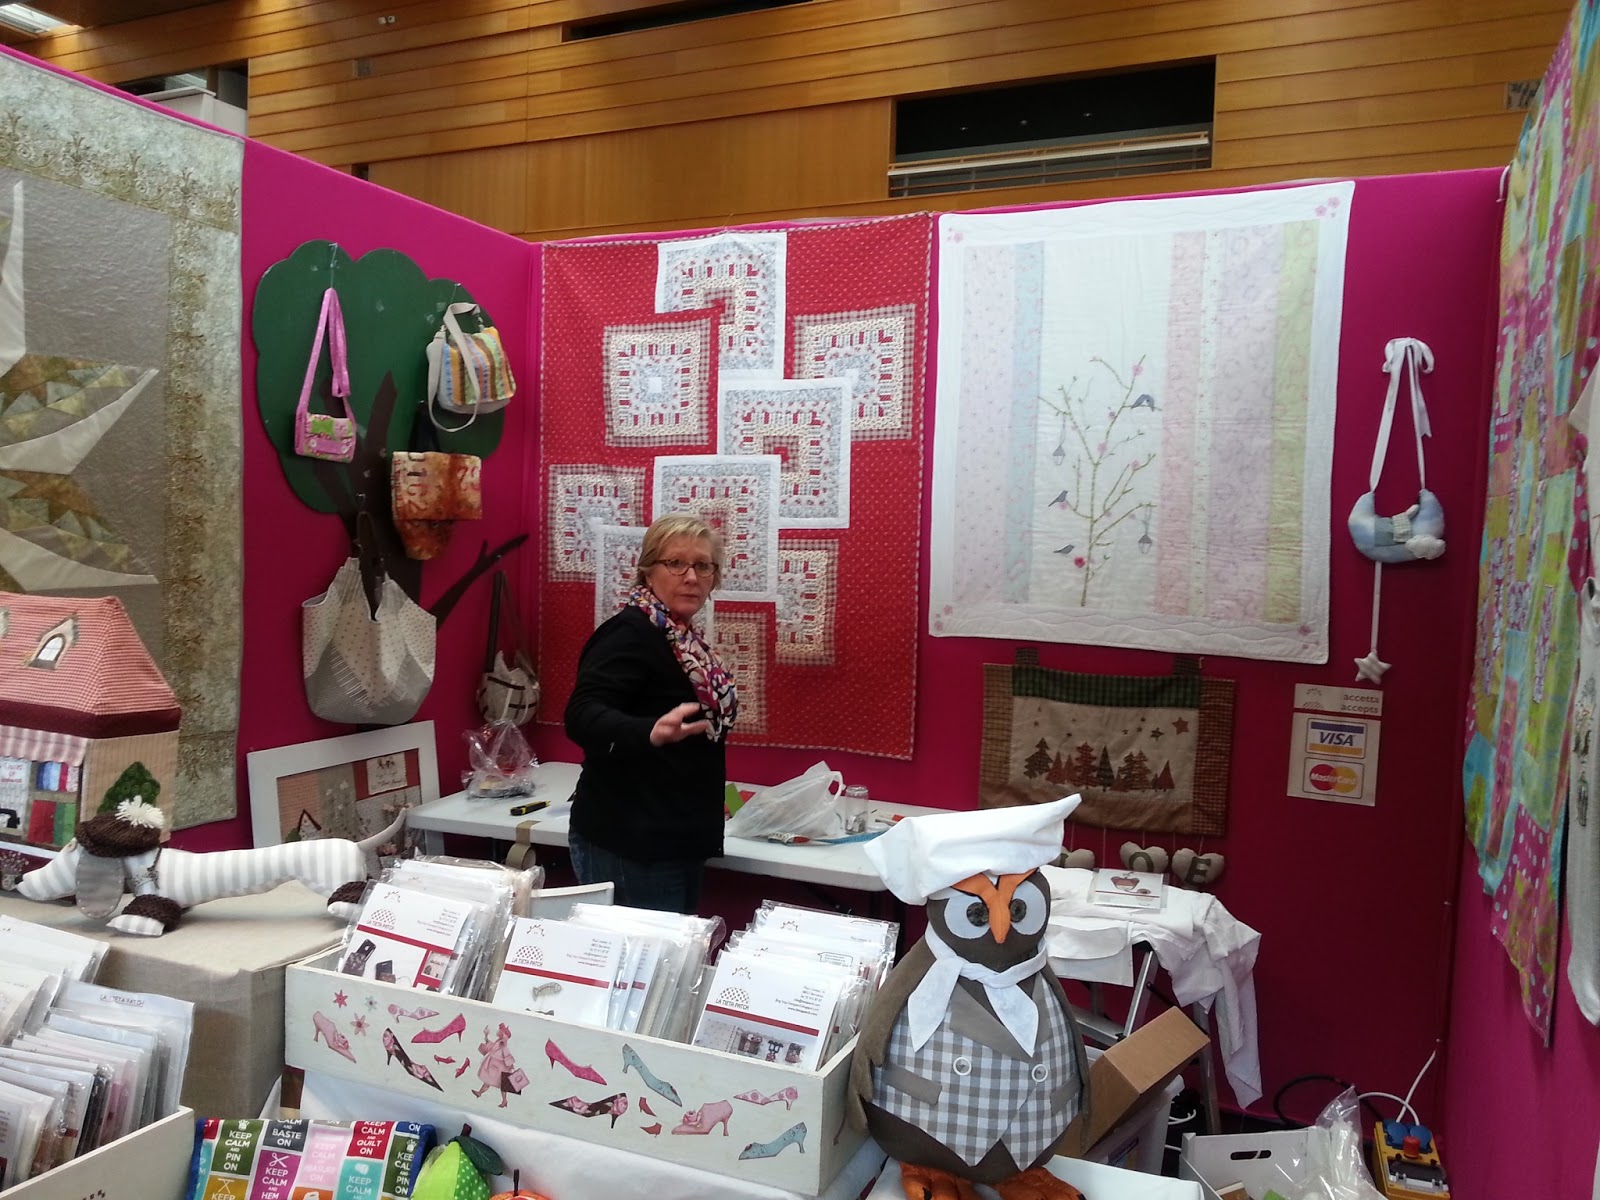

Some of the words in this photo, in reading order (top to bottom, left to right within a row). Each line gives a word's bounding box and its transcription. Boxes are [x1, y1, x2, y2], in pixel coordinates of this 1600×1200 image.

[1344, 694, 1379, 704] accetta
[1341, 704, 1379, 714] accepts
[1319, 732, 1354, 746] VISA
[229, 1130, 252, 1139] KEEP
[272, 1128, 301, 1139] BASTE
[361, 1127, 385, 1135] CALM
[277, 1138, 291, 1146] ON
[360, 1147, 373, 1155] ON
[226, 1153, 241, 1161] PIN
[397, 1152, 413, 1161] KEE
[223, 1162, 238, 1171] ON
[394, 1161, 410, 1170] CAL
[265, 1168, 288, 1176] KEEP
[262, 1177, 287, 1186] CALM
[349, 1176, 371, 1184] KEEP
[396, 1176, 410, 1185] PIN
[346, 1185, 371, 1195] CALM
[395, 1186, 408, 1195] ON
[261, 1192, 279, 1200] HEM
